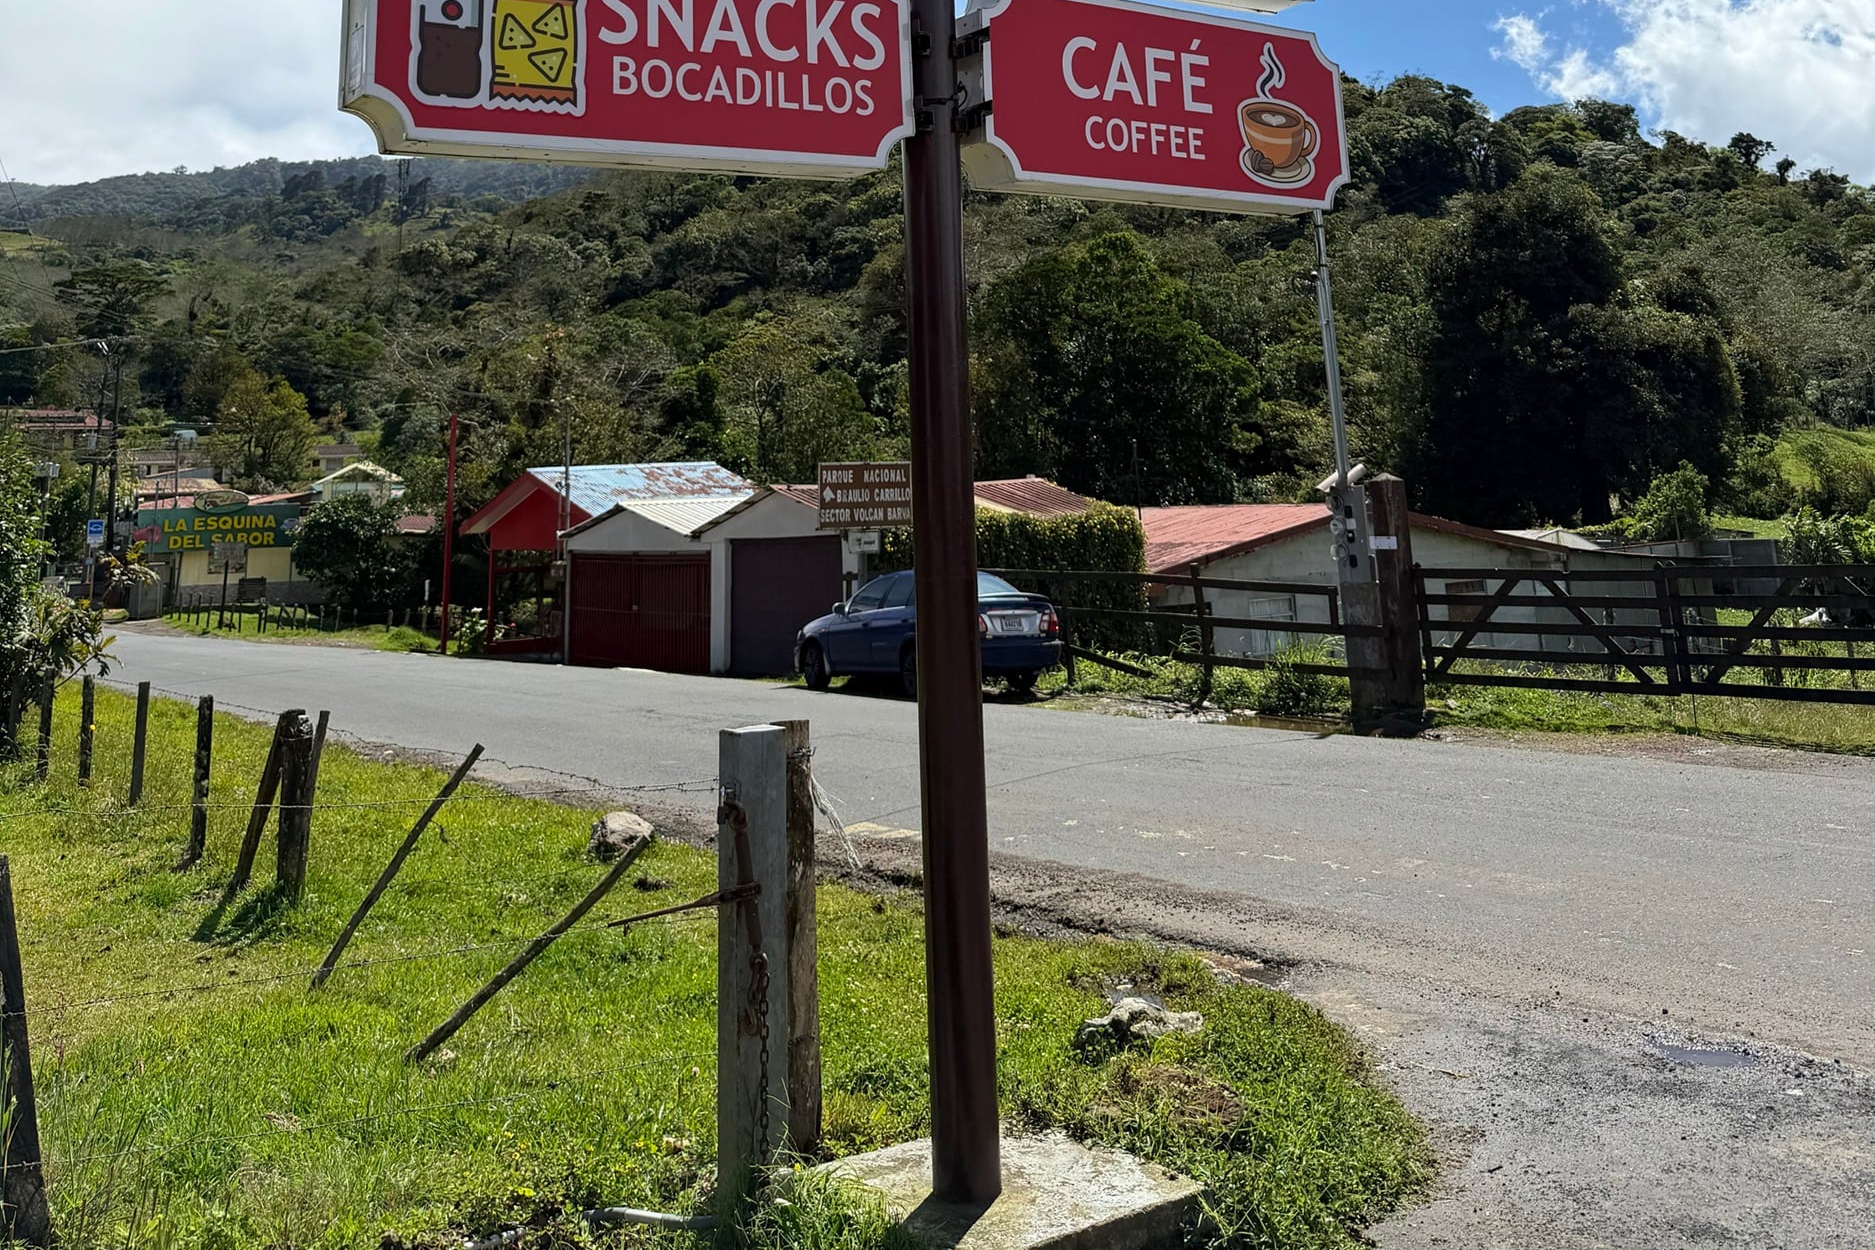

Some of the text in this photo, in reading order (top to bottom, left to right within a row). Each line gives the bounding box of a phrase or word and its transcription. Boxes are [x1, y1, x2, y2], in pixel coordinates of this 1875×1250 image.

[1062, 36, 1214, 114] CAFÉ
[612, 55, 875, 117] BOCADILLOS
[1085, 115, 1206, 160] COFFEE
[822, 469, 906, 483] PARQUE NACIONAL
[836, 487, 911, 503] BRAULIO CARRILLO
[163, 515, 276, 532] LA ESQUINA
[820, 508, 851, 523] SECTOR
[853, 508, 884, 521] VOLCAN
[169, 534, 204, 549] DEL
